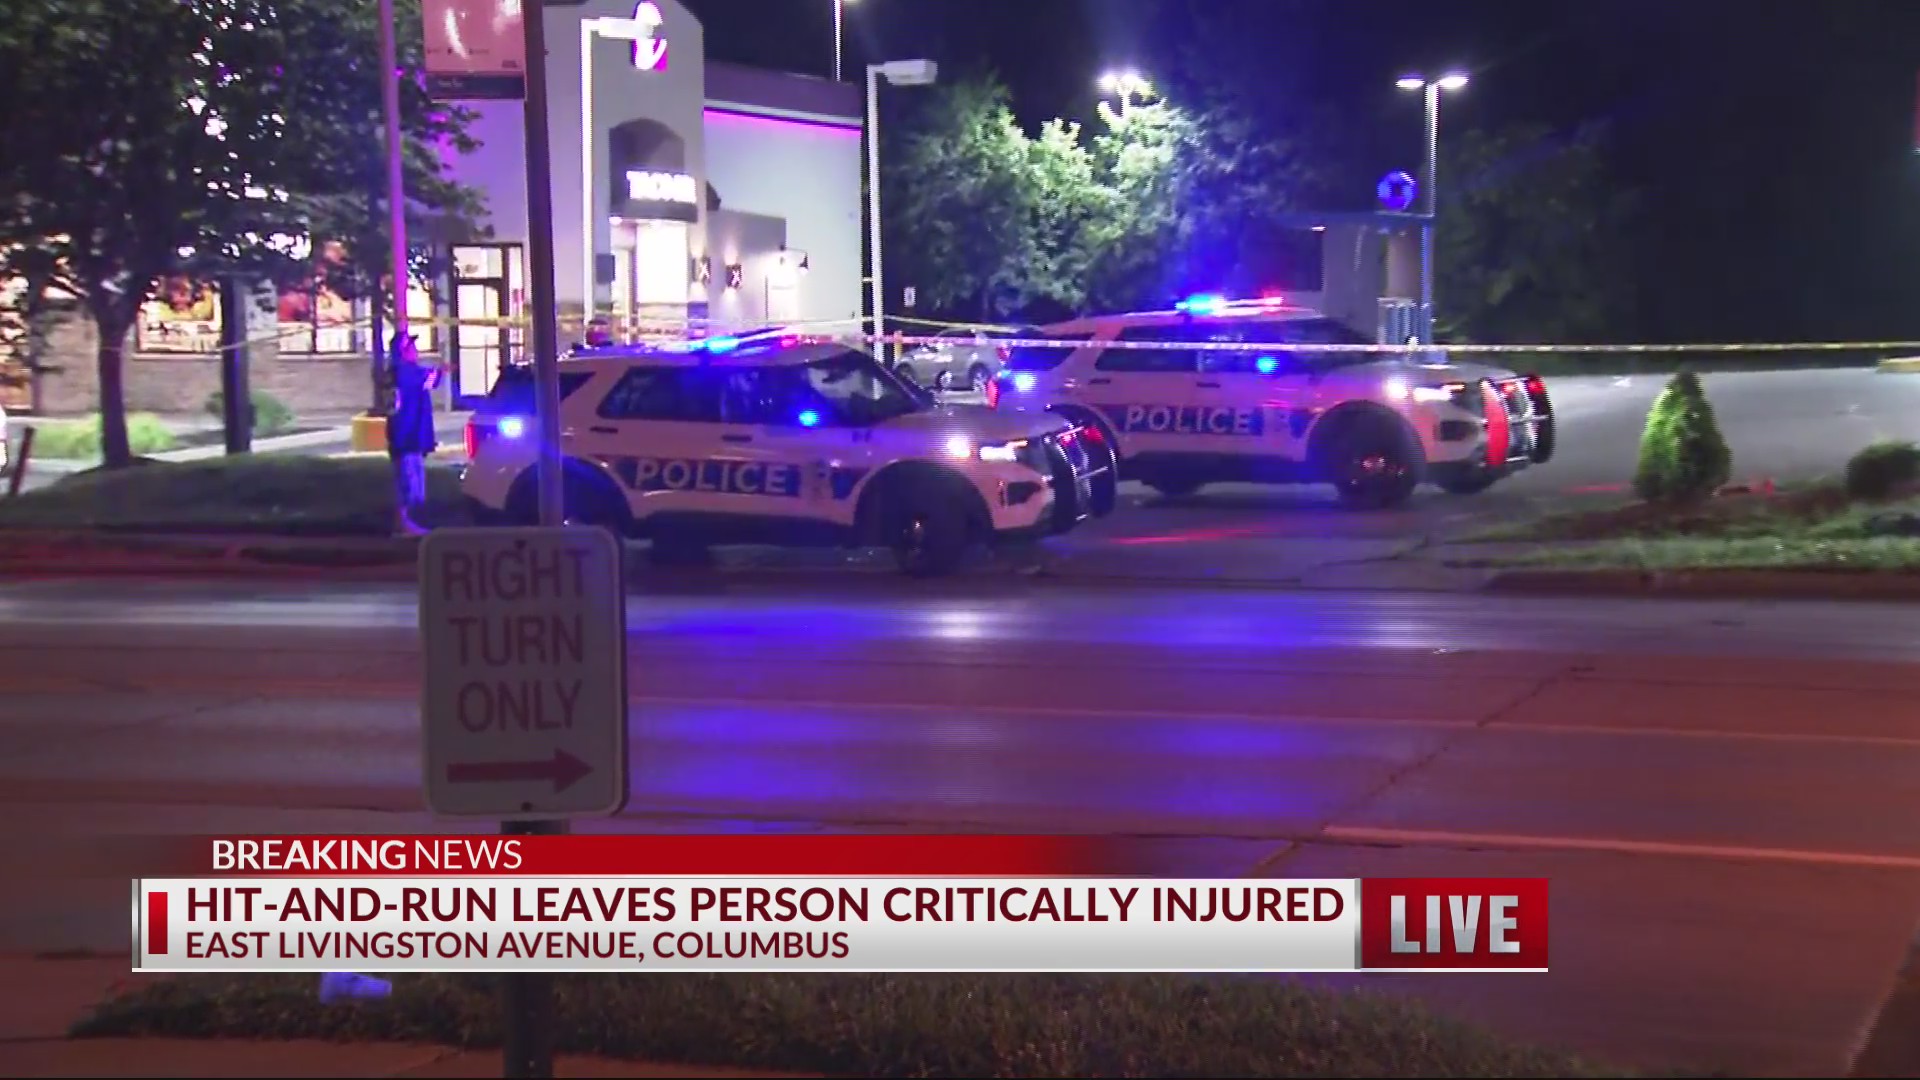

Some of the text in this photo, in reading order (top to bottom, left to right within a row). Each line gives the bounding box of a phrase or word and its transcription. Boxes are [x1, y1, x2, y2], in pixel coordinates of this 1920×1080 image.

[1124, 403, 1251, 434] POLICE
[635, 457, 789, 493] POLICE
[442, 548, 591, 600] RIGHT
[447, 614, 584, 667] TURN
[457, 679, 583, 732] ONLY
